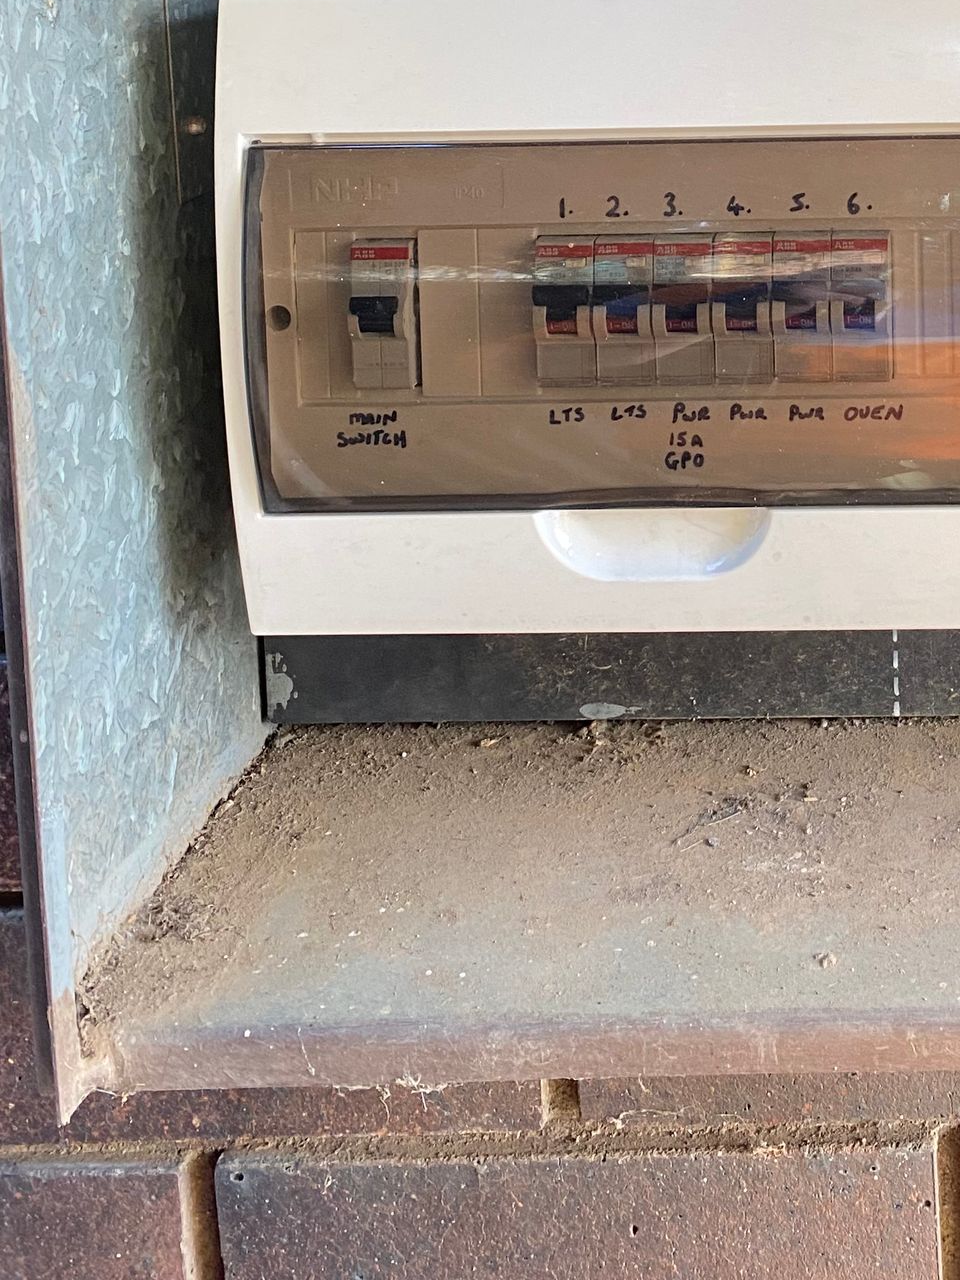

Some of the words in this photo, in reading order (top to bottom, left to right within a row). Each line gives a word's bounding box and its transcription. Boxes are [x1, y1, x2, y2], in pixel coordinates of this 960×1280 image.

[605, 195, 629, 218] 2.
[663, 191, 683, 217] 3.
[726, 195, 752, 216] 4.
[789, 192, 810, 212] 5.
[847, 192, 873, 215] 6.
[349, 409, 398, 426] MAIN
[549, 406, 585, 425] LTS
[610, 404, 648, 421] LTS
[336, 430, 408, 448] SWITCH
[664, 451, 705, 471] GPO
